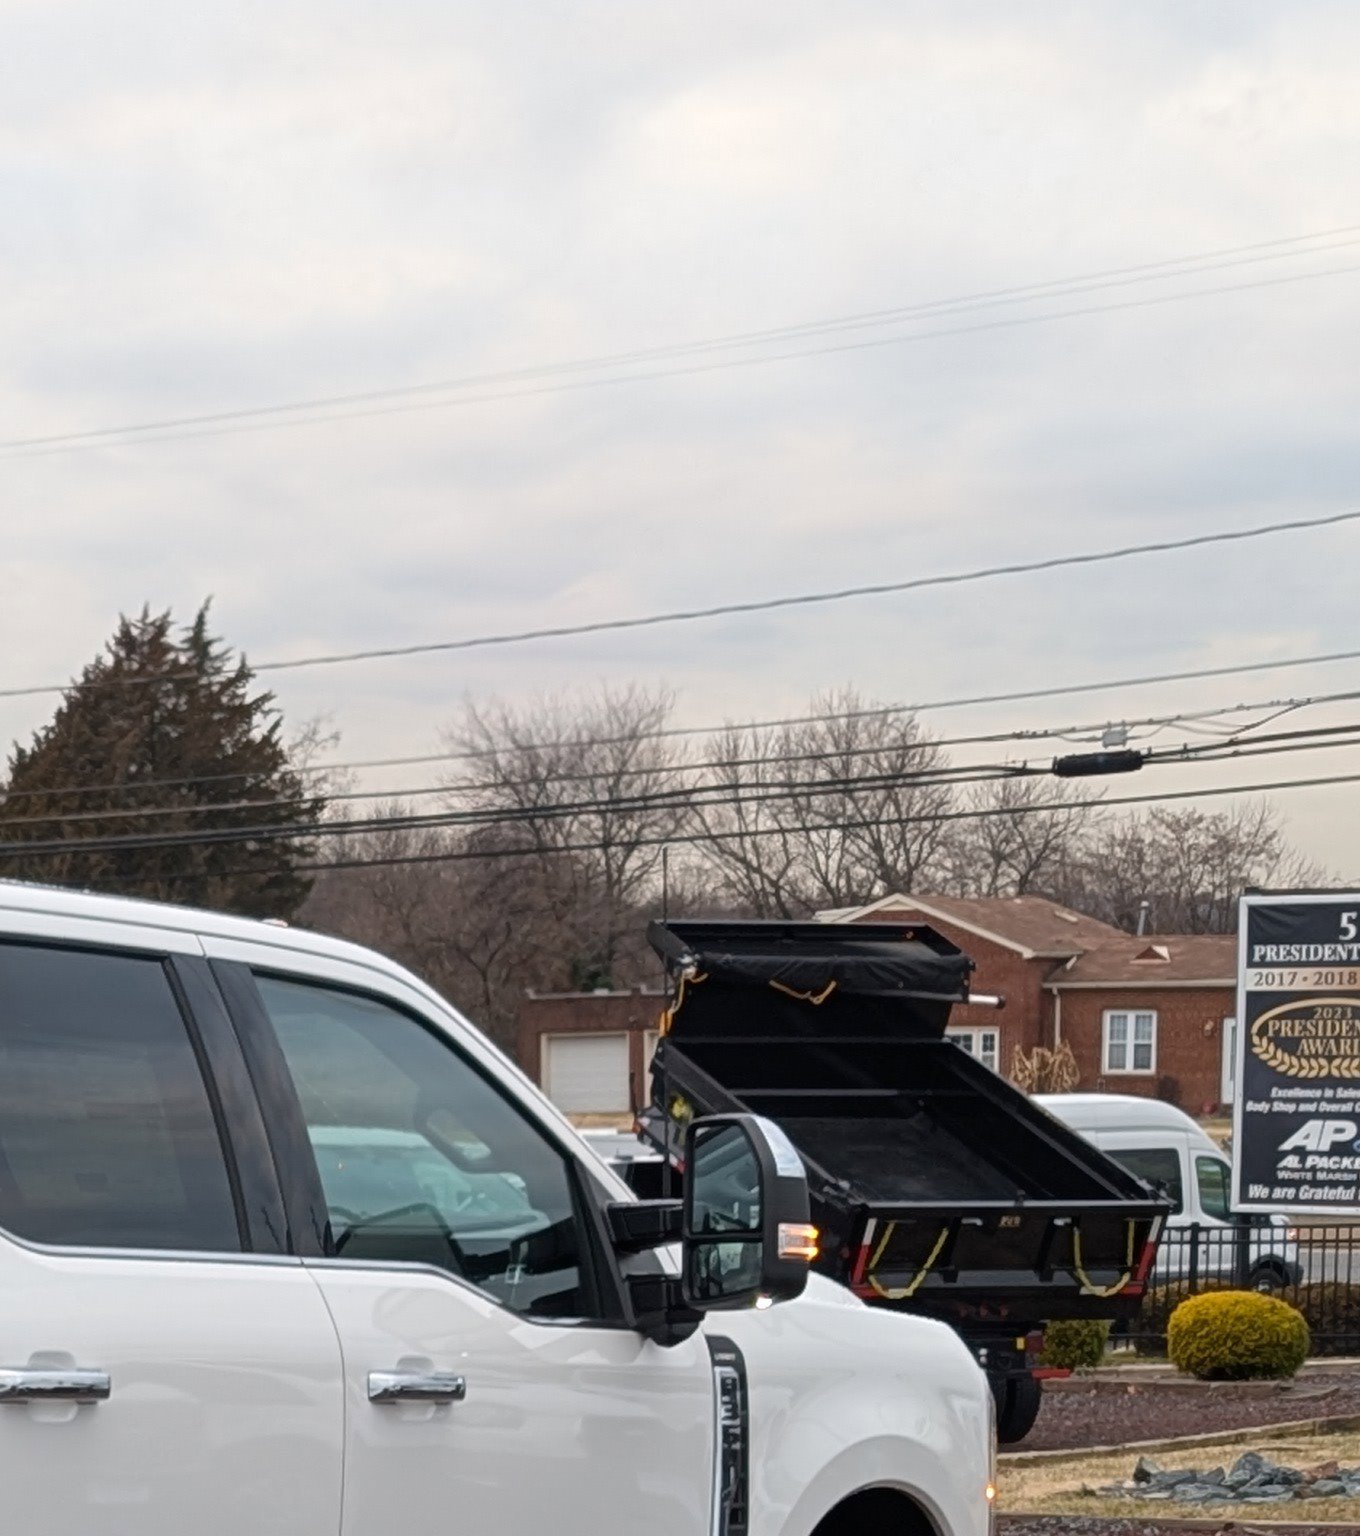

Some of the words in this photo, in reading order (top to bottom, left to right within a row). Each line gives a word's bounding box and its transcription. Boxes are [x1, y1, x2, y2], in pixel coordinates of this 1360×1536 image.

[1339, 911, 1358, 940] 5
[1254, 971, 1297, 986] 2017
[1313, 970, 1357, 986] 2018
[1313, 1006, 1353, 1019] 2023
[1272, 1101, 1296, 1114] Shop
[1298, 1102, 1317, 1112] and
[1319, 1102, 1354, 1113] Overall
[1278, 1120, 1358, 1152] AP
[1276, 1154, 1302, 1168] AL
[1248, 1184, 1269, 1199] We
[1271, 1187, 1296, 1200] are
[1299, 1184, 1356, 1200] Grateful
